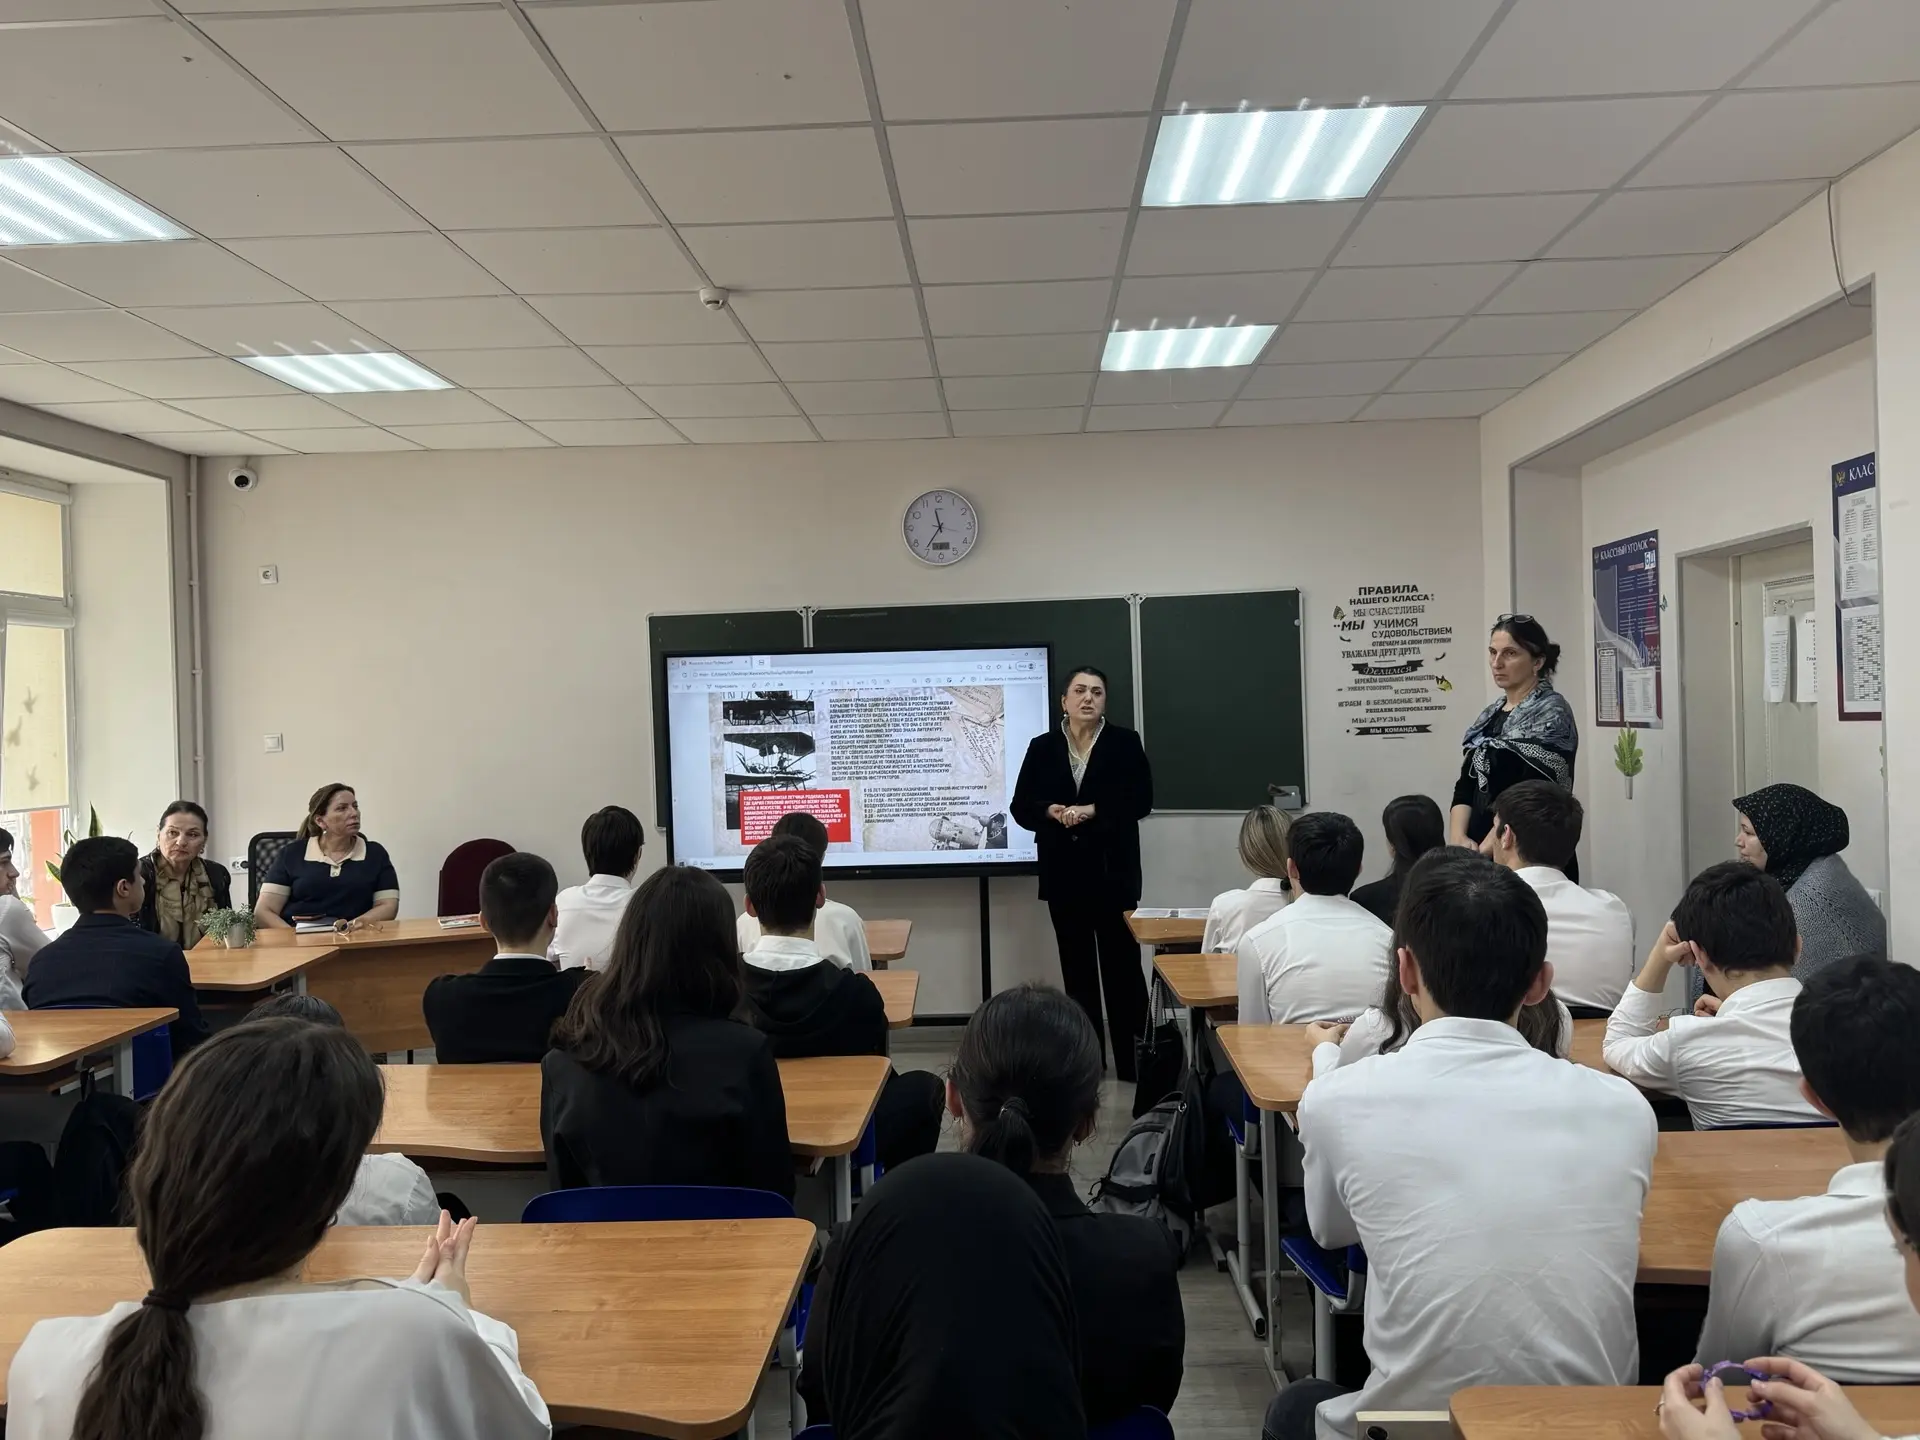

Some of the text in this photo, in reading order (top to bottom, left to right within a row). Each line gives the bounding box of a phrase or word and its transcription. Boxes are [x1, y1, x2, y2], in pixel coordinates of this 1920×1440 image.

[922, 500, 928, 508] 11
[960, 508, 968, 516] 2
[966, 522, 972, 530] 3
[913, 539, 920, 548] 8
[962, 536, 968, 544] 4
[952, 547, 958, 556] 5
[1600, 539, 1648, 560] КЛАССНЫЙ УГОЛОК
[1358, 584, 1418, 596] ПРАВИЛА
[1349, 596, 1389, 606] НАШЕГО
[1353, 605, 1425, 617] МЫ СЧАСТЛИВЫ
[1341, 618, 1418, 631] МЫ УЧИМСЯ
[1379, 627, 1452, 638] УДОВОЛЬСТВИЕМ
[1342, 646, 1421, 659] УВАЖАЕМ ДРУГ ДРУГА
[1363, 665, 1412, 675] Делимся
